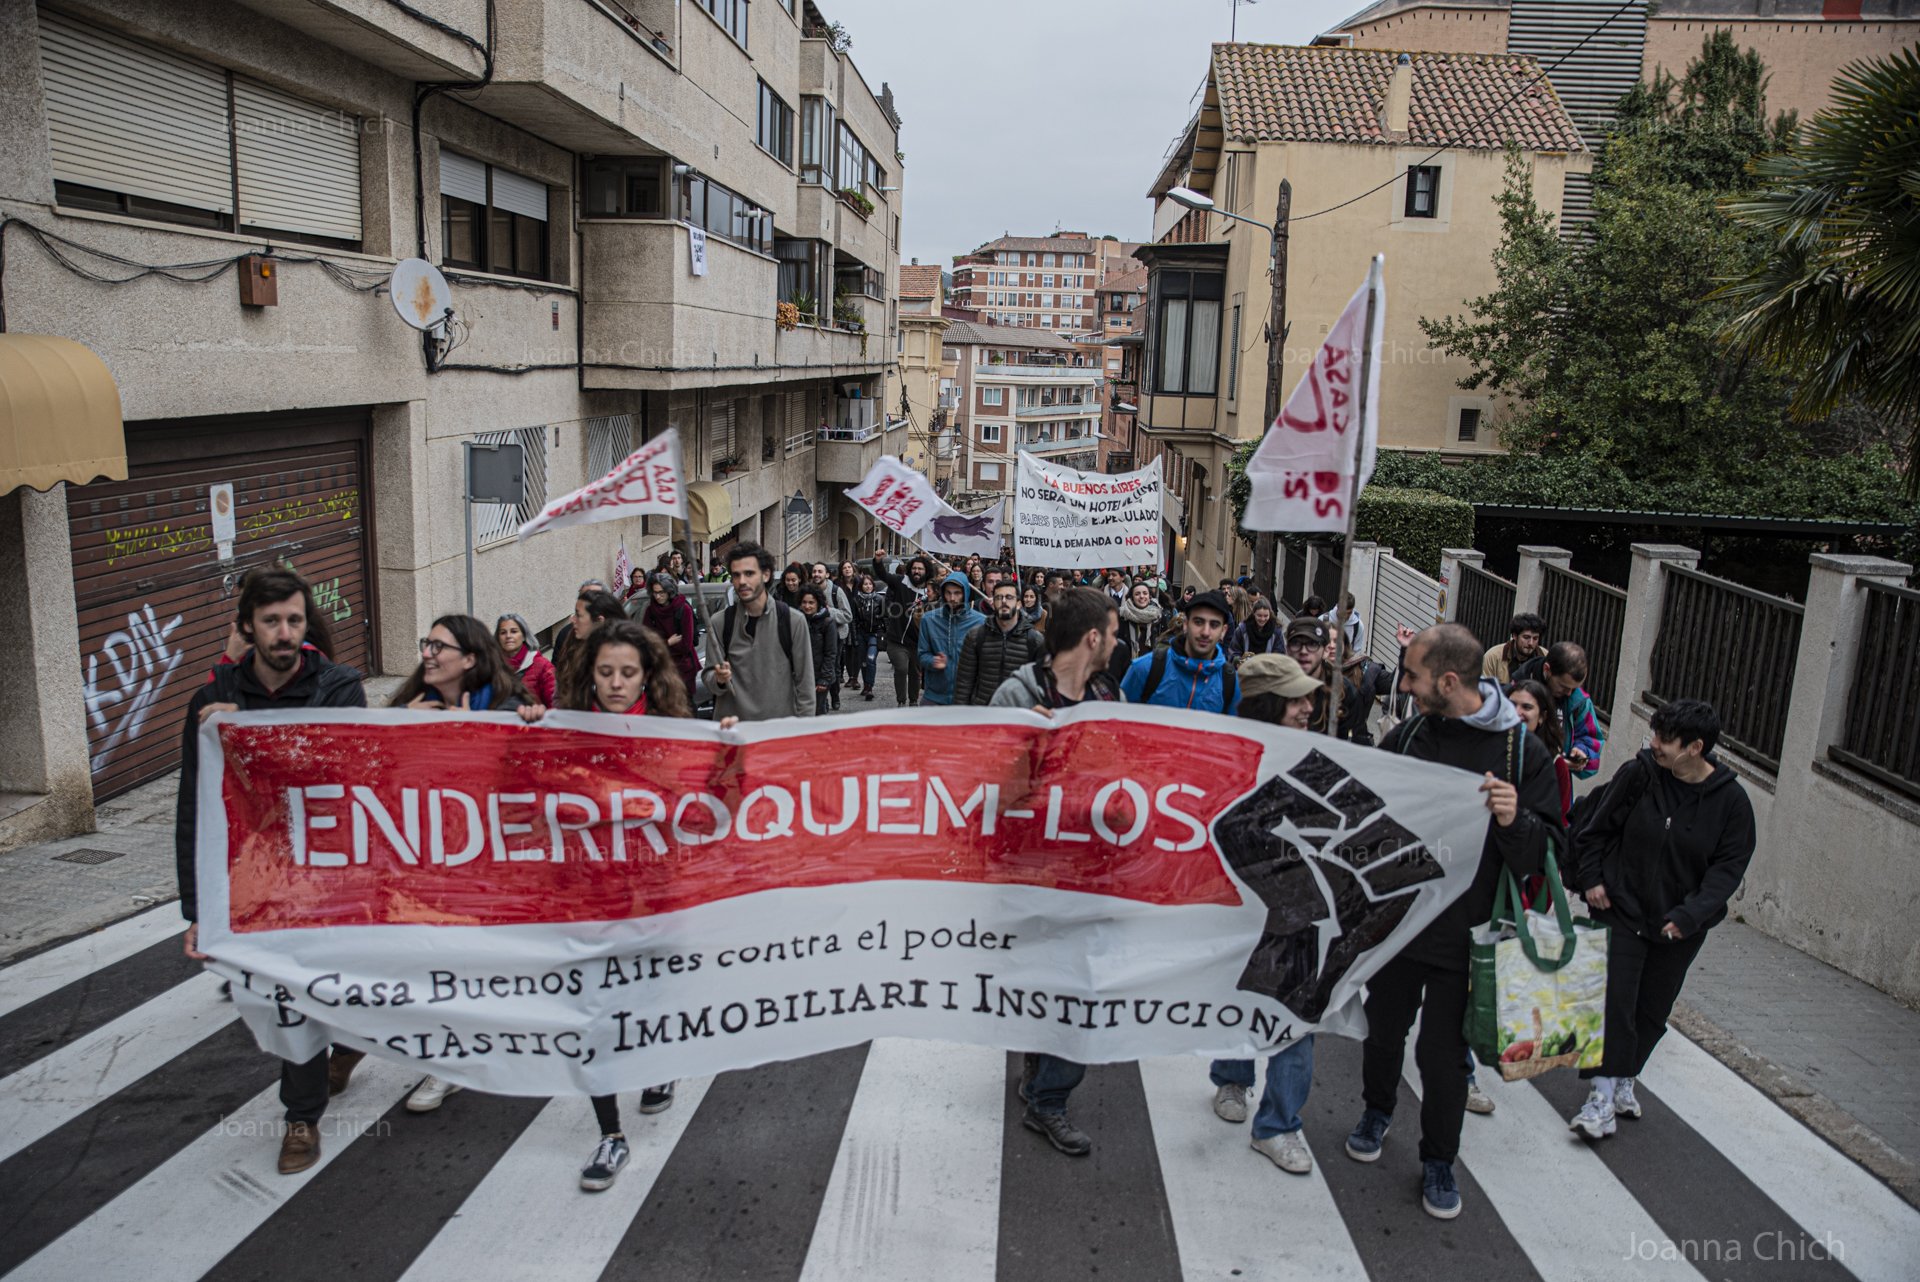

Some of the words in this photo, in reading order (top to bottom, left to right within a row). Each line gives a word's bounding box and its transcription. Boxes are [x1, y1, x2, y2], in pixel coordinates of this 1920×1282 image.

[1021, 486, 1035, 499] NO
[1070, 498, 1086, 511] UN
[1063, 481, 1108, 495] BUENOS
[1111, 479, 1142, 494] AIRES
[1019, 535, 1049, 547] RETIREU
[1051, 539, 1062, 548] LA
[1064, 536, 1111, 549] DEMANDA
[1125, 536, 1141, 546] NO
[285, 773, 1208, 867] ENDERROQUEM-LOS
[306, 965, 416, 1008] Casa
[427, 967, 584, 1004] Buenos
[599, 952, 702, 989] Aires
[716, 933, 842, 967] contra
[857, 920, 888, 950] el
[901, 919, 1017, 960] poder
[612, 978, 930, 1053] IMMOBILIARI
